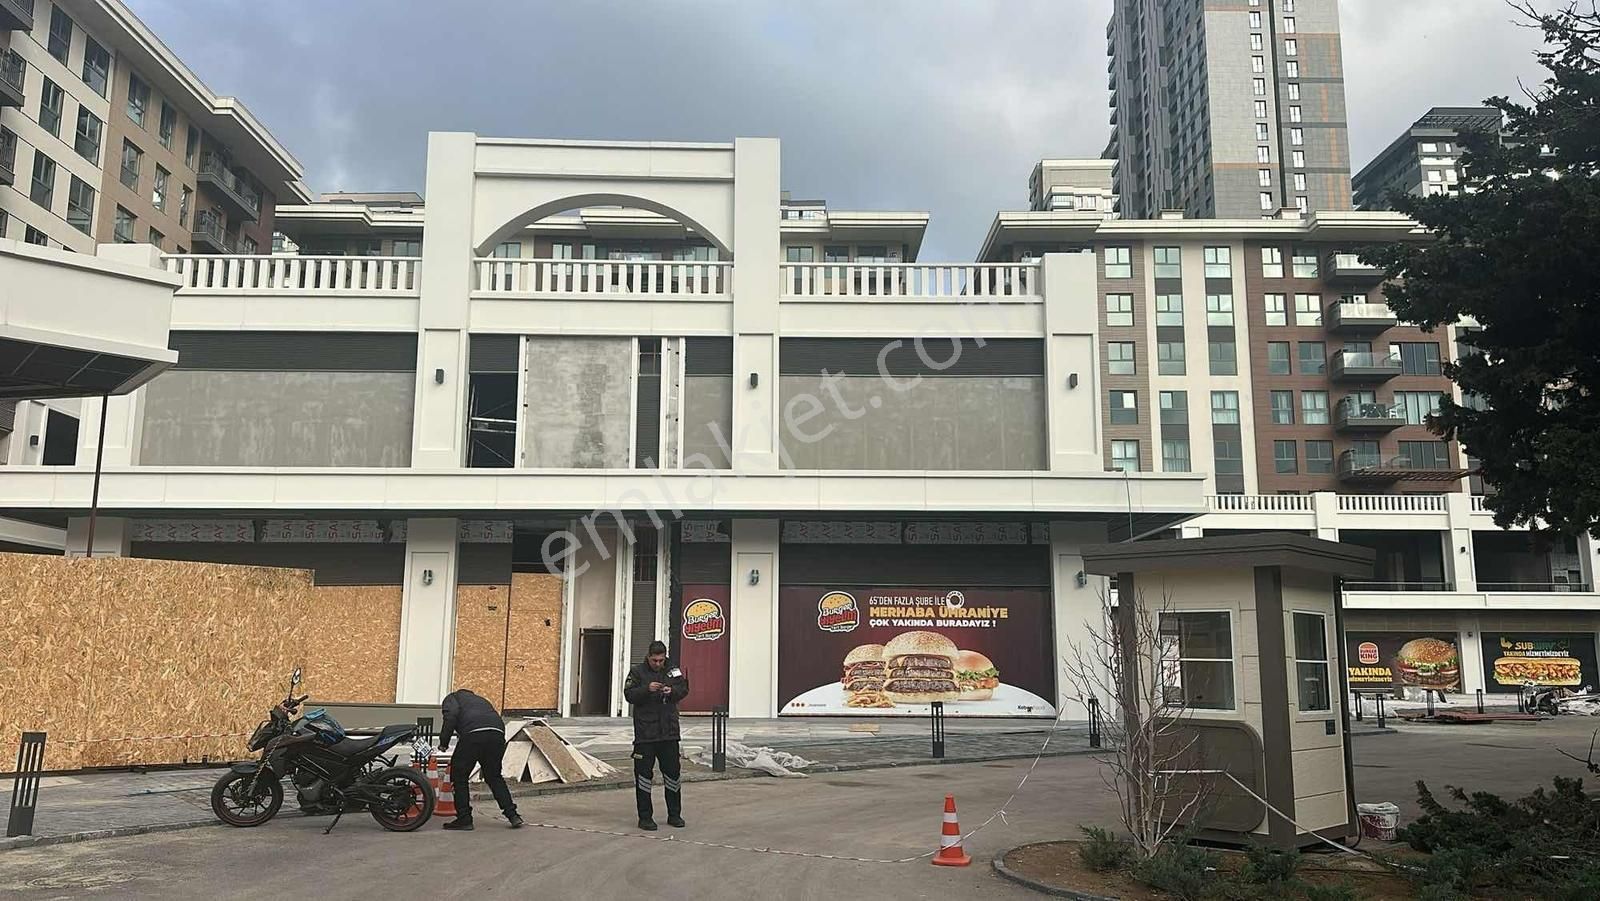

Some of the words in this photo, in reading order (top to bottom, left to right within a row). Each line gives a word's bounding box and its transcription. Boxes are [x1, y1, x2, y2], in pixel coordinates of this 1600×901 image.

[894, 596, 914, 606] FAZLA
[915, 596, 933, 608] ŞUBE
[869, 606, 935, 618] MERHABA
[939, 605, 1008, 618] ÜMRANİYE
[869, 619, 889, 627] ÇOK
[892, 619, 934, 627] YAKINDA
[936, 619, 990, 627] BURADAYIZ
[1348, 667, 1392, 676] YAKINDA
